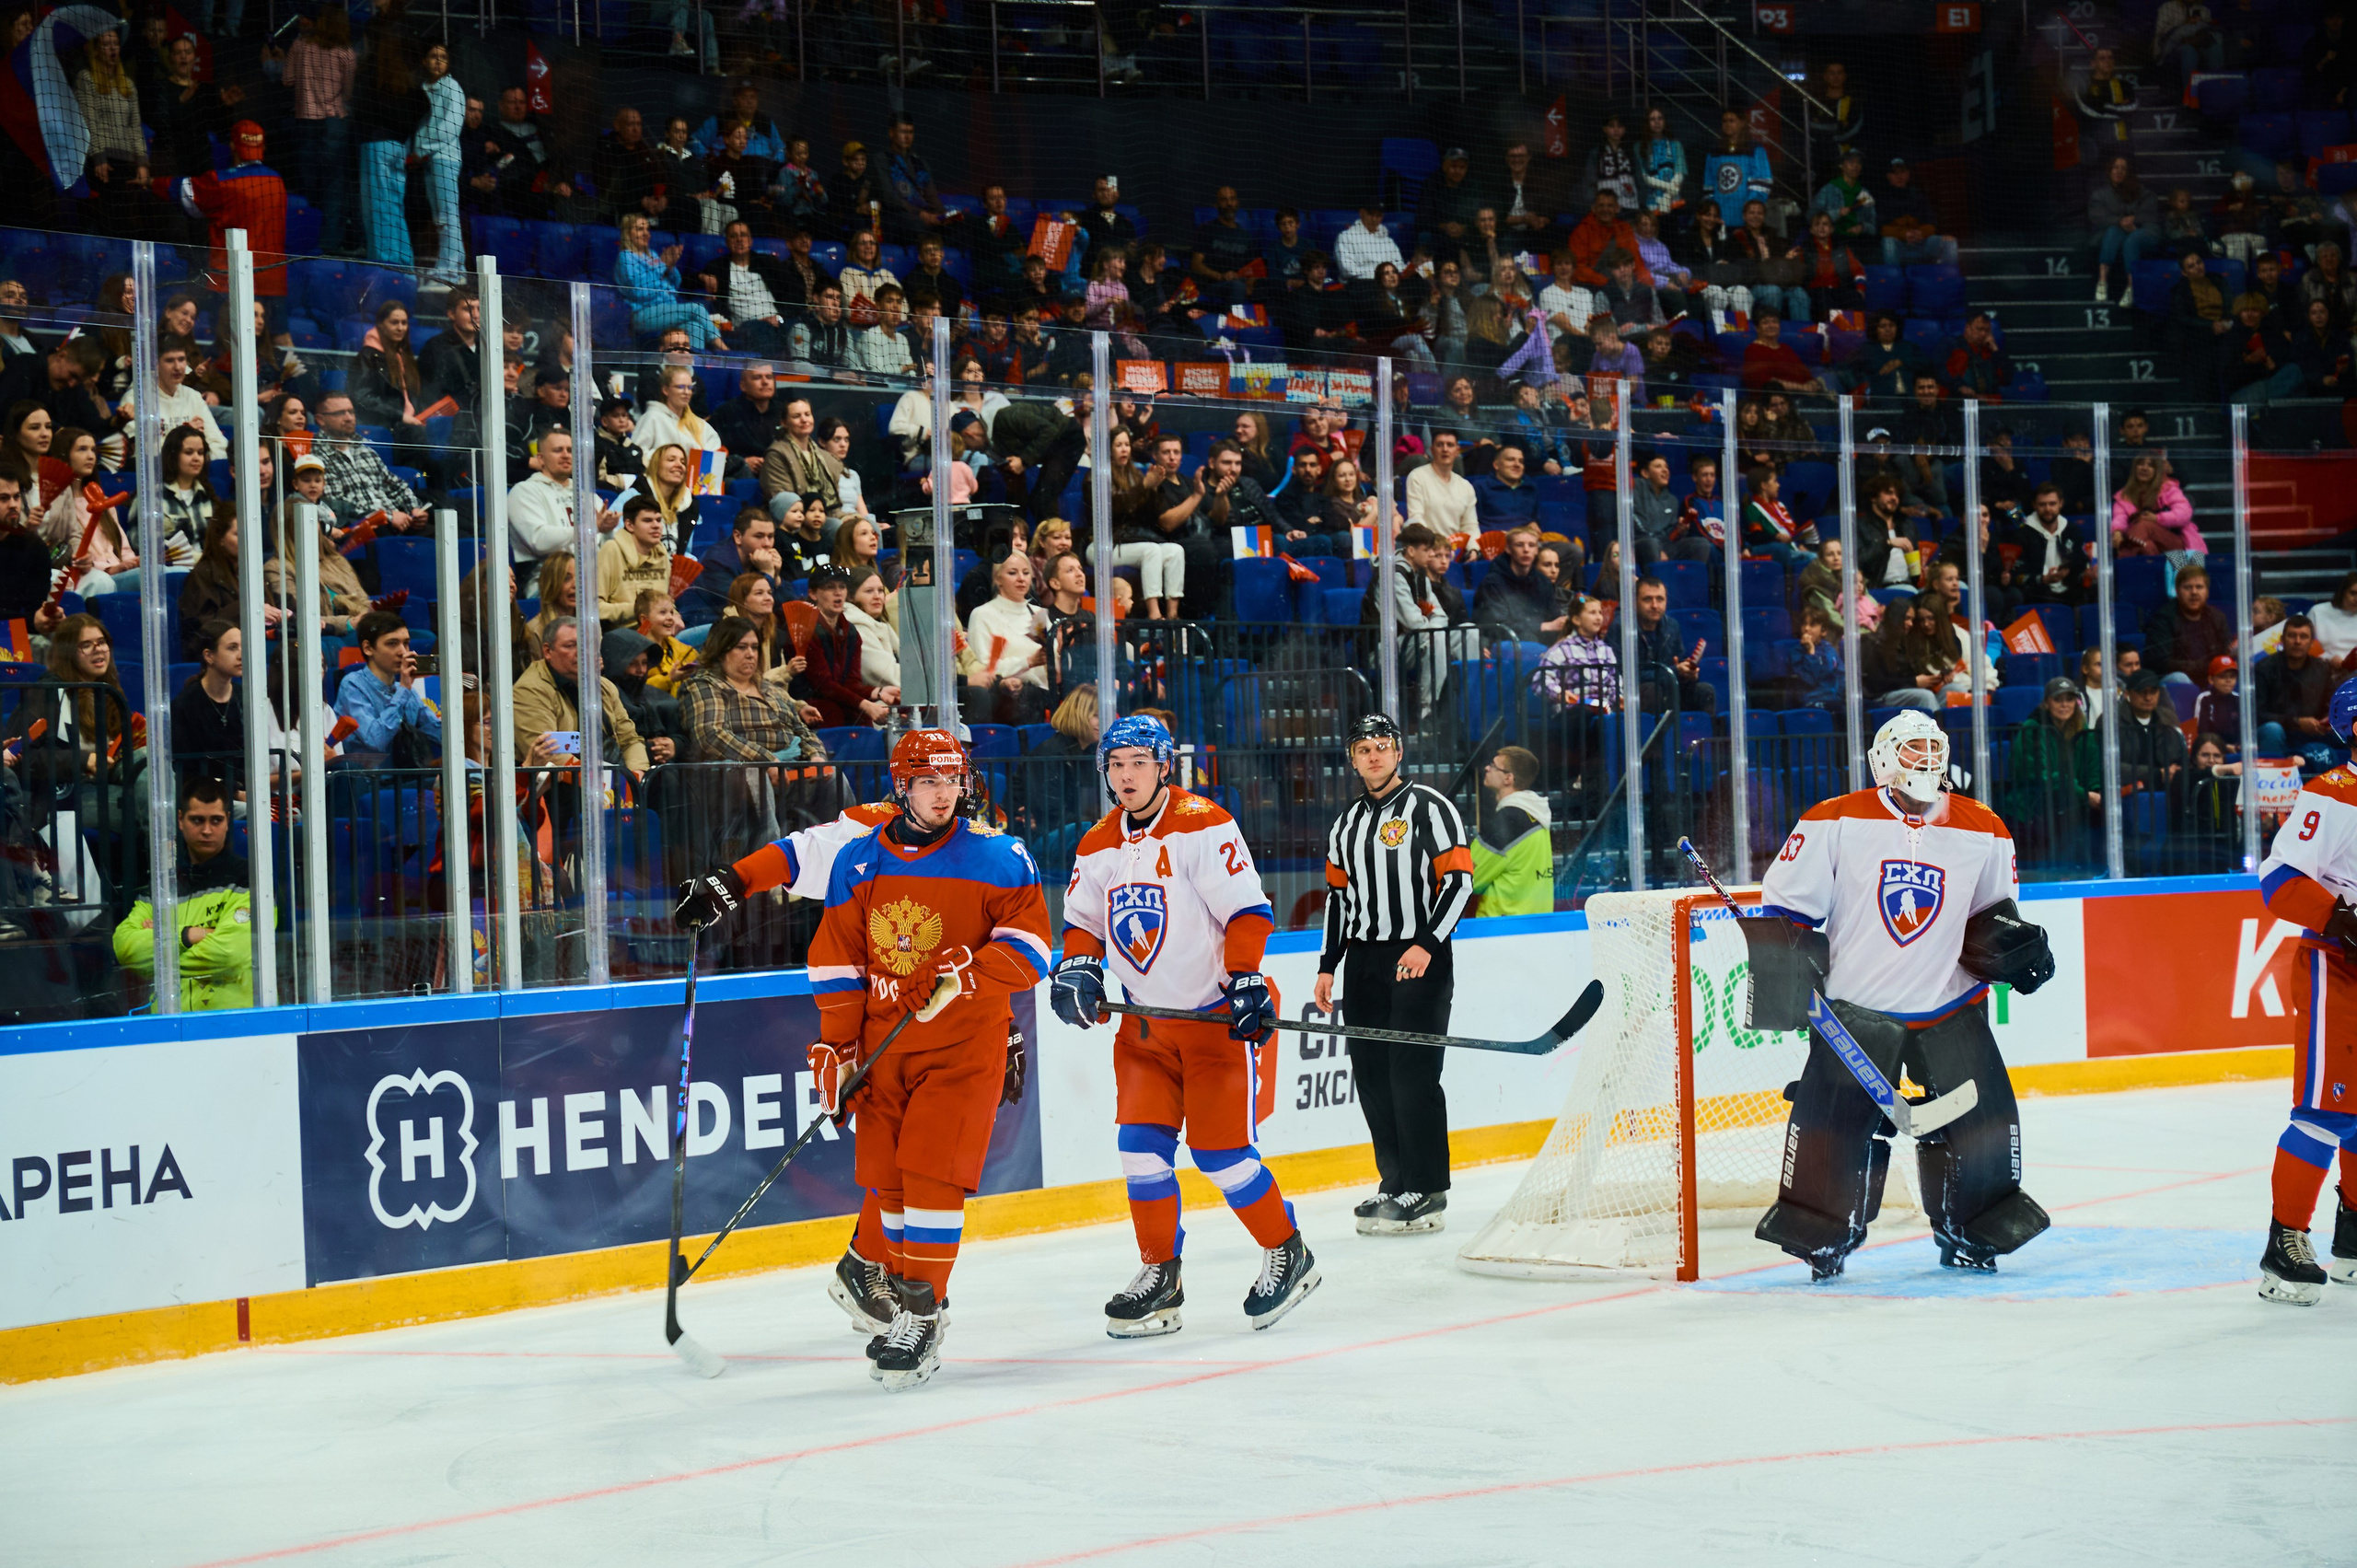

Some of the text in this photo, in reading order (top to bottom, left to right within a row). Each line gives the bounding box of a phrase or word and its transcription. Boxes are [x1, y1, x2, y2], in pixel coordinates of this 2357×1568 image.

[1947, 7, 1970, 27] E1
[2154, 113, 2176, 130] 17
[2197, 159, 2221, 176] 16
[2045, 256, 2070, 276] 14
[2084, 308, 2111, 329] 13
[2129, 360, 2155, 380] 12
[2175, 417, 2197, 436] 11
[1155, 844, 1173, 879] A
[1884, 864, 1942, 891] СХЛ
[1111, 887, 1164, 912] СХЛ
[1993, 914, 2022, 928] BAUER
[1819, 1019, 1894, 1100] BAUER
[498, 1070, 857, 1180] HENDER
[1782, 1122, 1801, 1190] BAUER
[2009, 1124, 2020, 1180] BAUER
[0, 1143, 193, 1222] РЕНА
